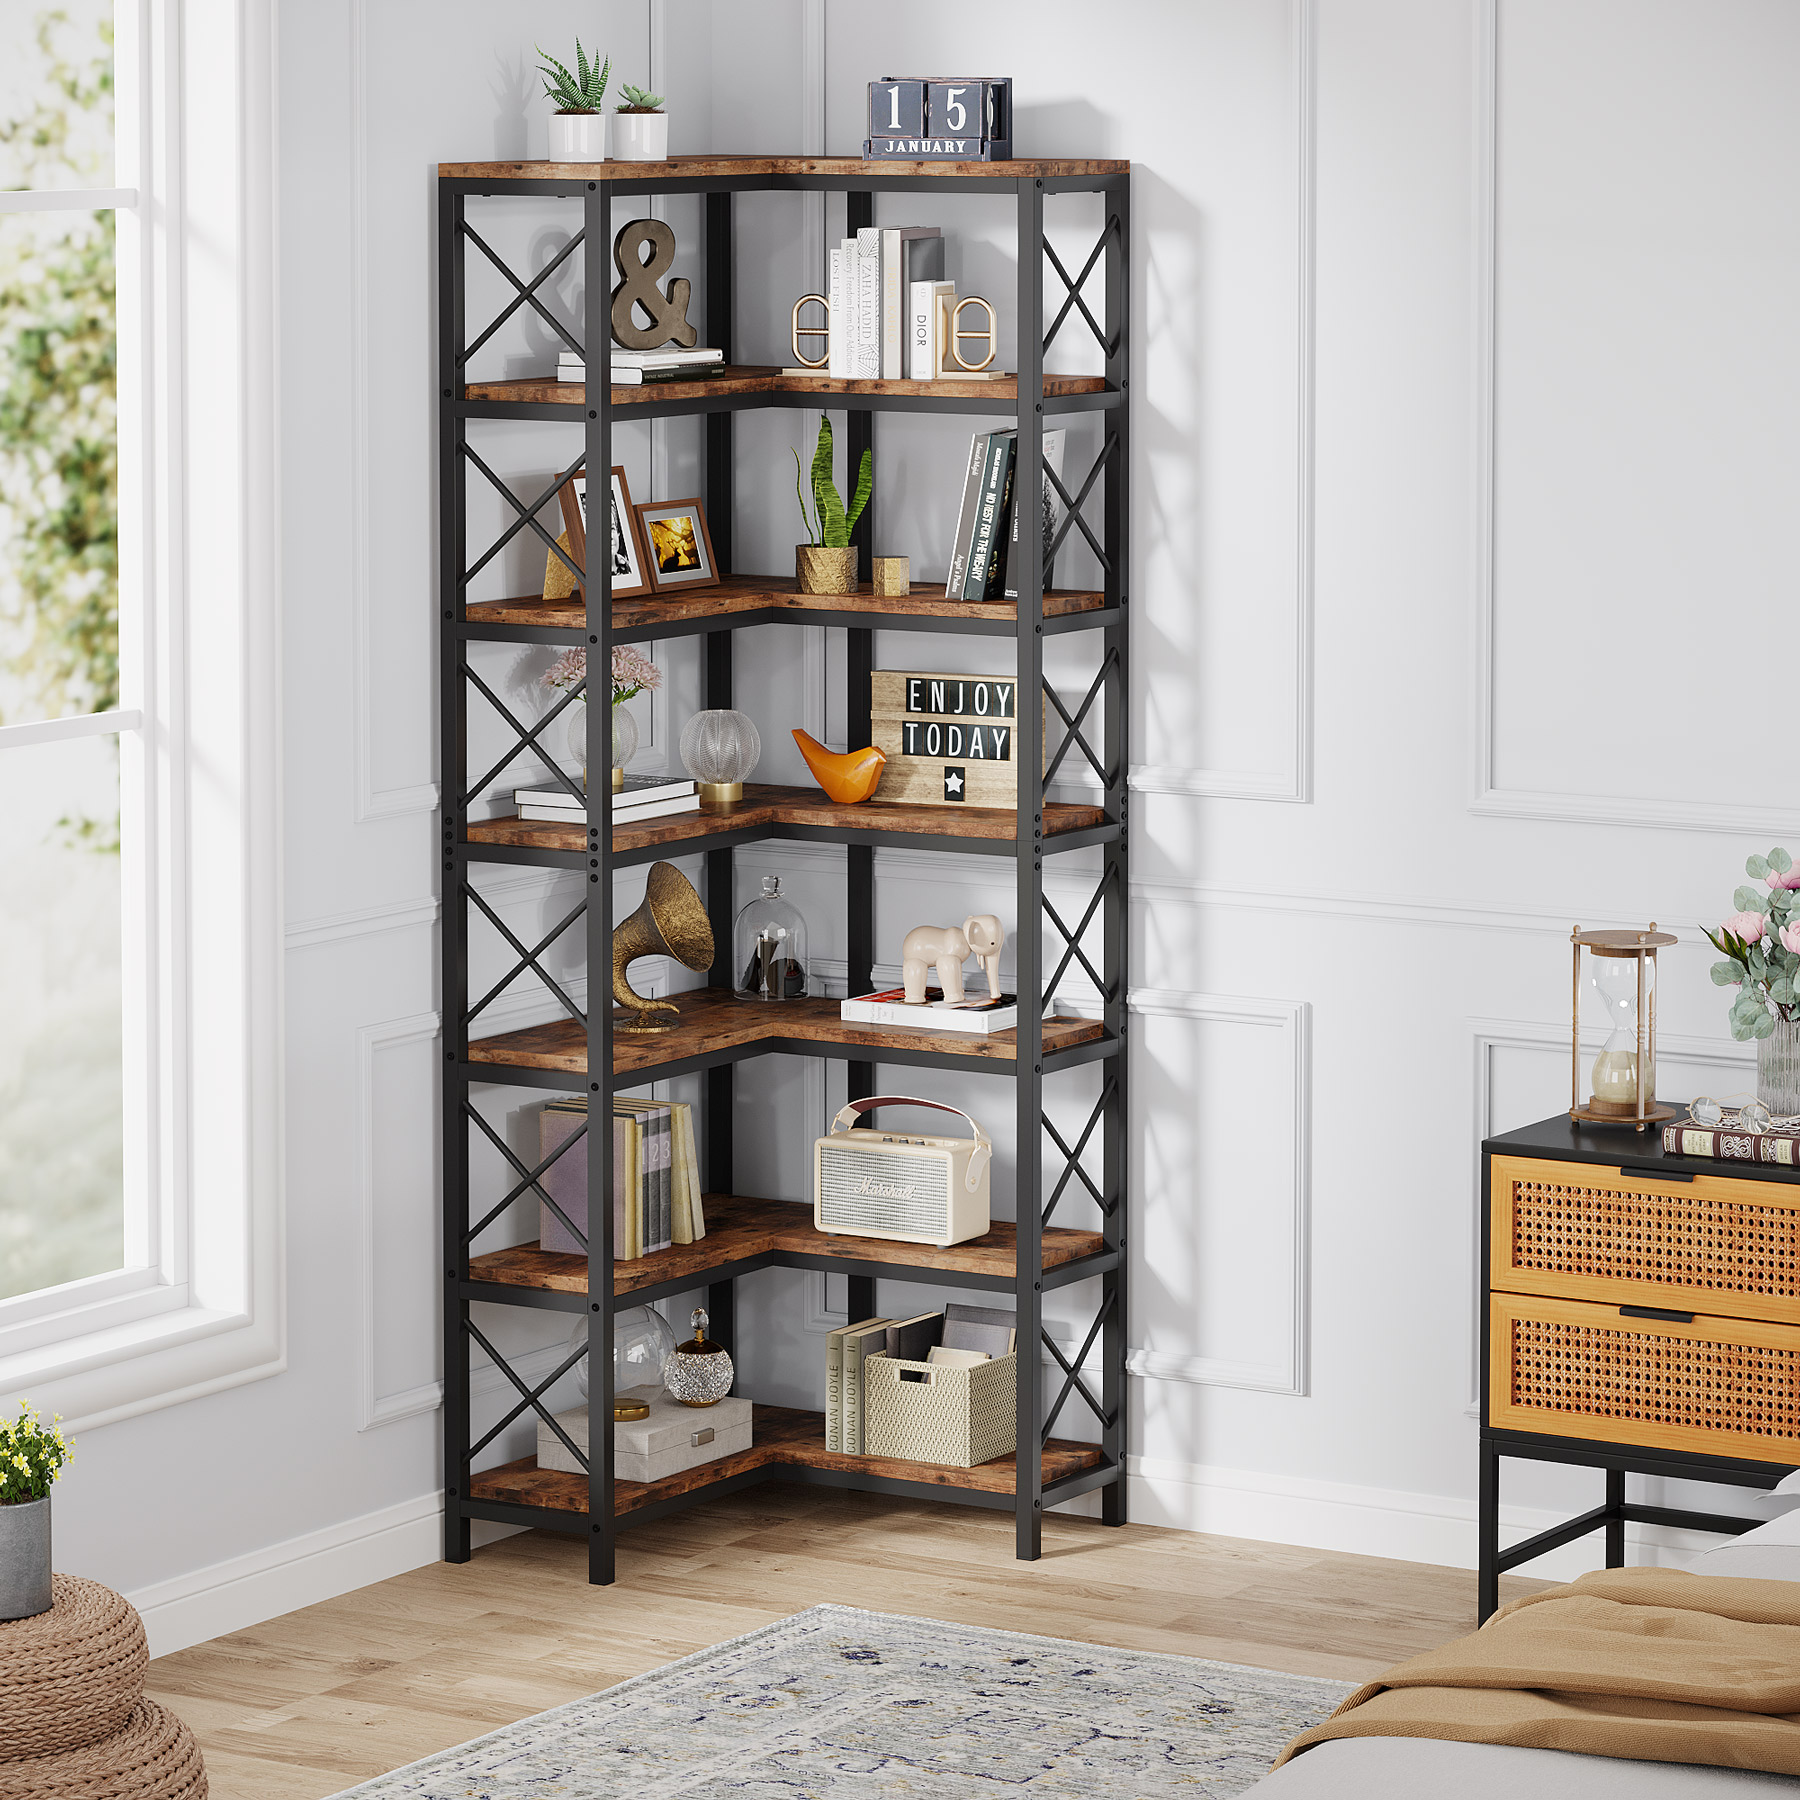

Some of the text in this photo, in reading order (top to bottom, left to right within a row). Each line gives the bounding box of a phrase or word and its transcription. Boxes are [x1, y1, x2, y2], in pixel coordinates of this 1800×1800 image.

[888, 86, 901, 129] 1
[947, 88, 966, 131] 5
[885, 140, 966, 153] JANUARY
[832, 252, 840, 312] LOST FISH
[845, 276, 855, 306] Freedom
[845, 307, 855, 323] From
[861, 264, 872, 339] ZAHA HADID
[887, 267, 897, 344] FRIDA KAHLO
[845, 324, 855, 339] Our
[916, 315, 927, 346] DIOR
[845, 339, 855, 374] Addictions
[971, 492, 996, 582] NO REST FOR THE WEARY
[910, 679, 1011, 717] ENJOY
[905, 723, 1007, 760] TODAY
[651, 1143, 659, 1162] 2
[662, 1140, 670, 1159] 3
[854, 1177, 917, 1200] Marshall
[829, 1364, 839, 1403] DOYLE
[846, 1345, 856, 1454] CONAN DOYLE II
[829, 1408, 839, 1452] CONAN
